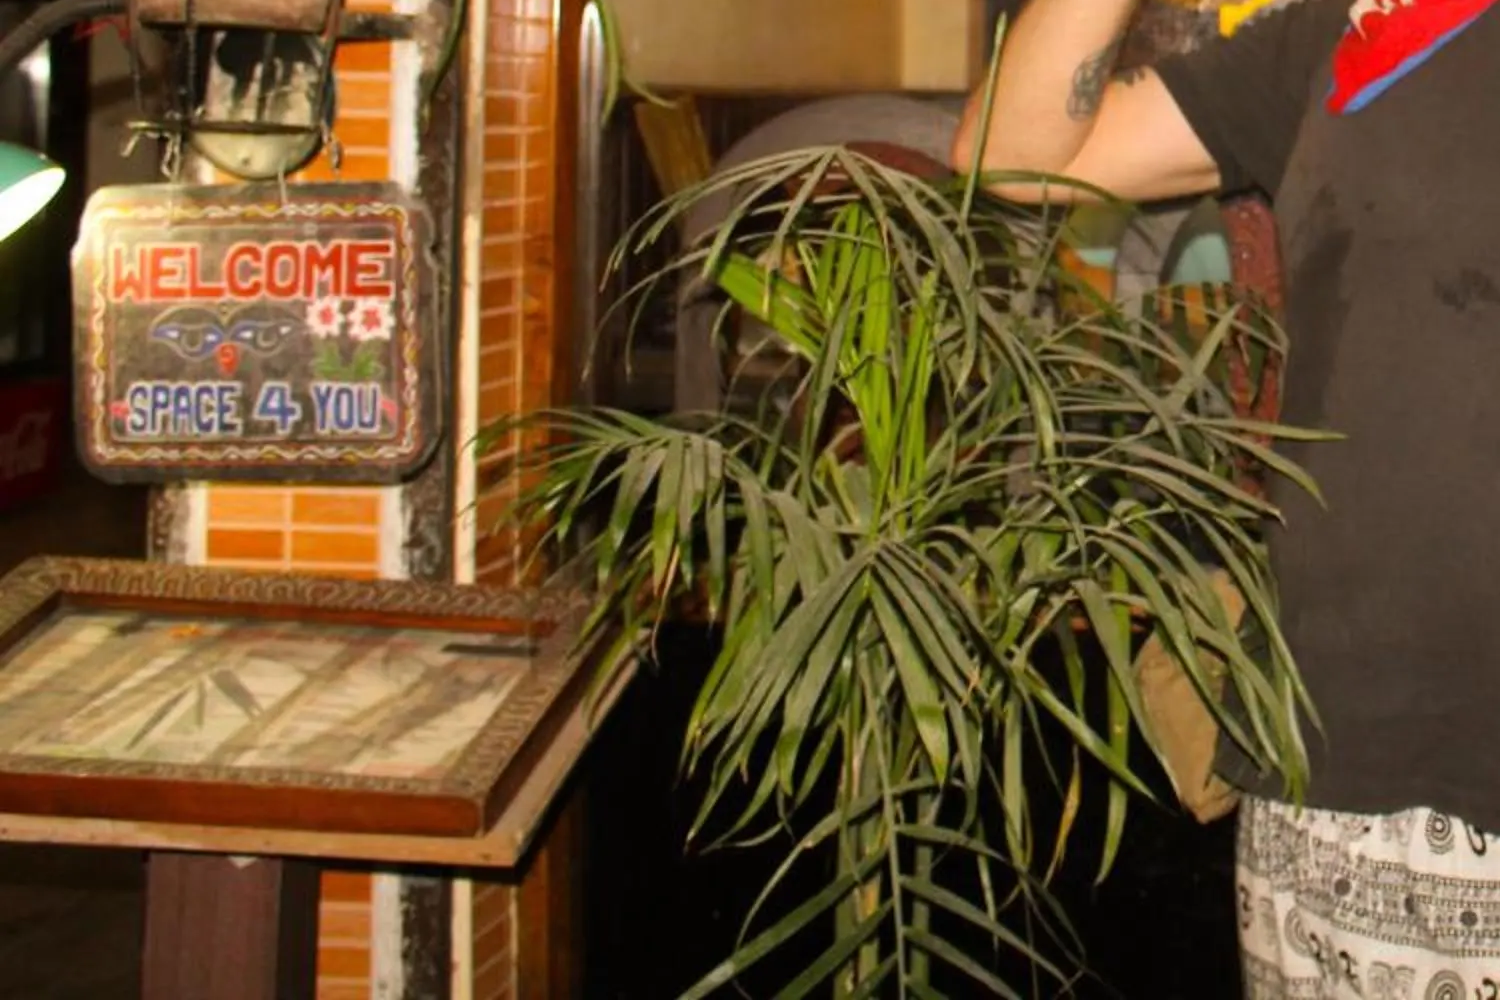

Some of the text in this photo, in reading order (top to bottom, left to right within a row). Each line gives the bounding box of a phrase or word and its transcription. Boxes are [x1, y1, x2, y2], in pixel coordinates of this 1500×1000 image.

[110, 240, 396, 302] WELCOME
[127, 381, 382, 435] SPACE 4 YOU
